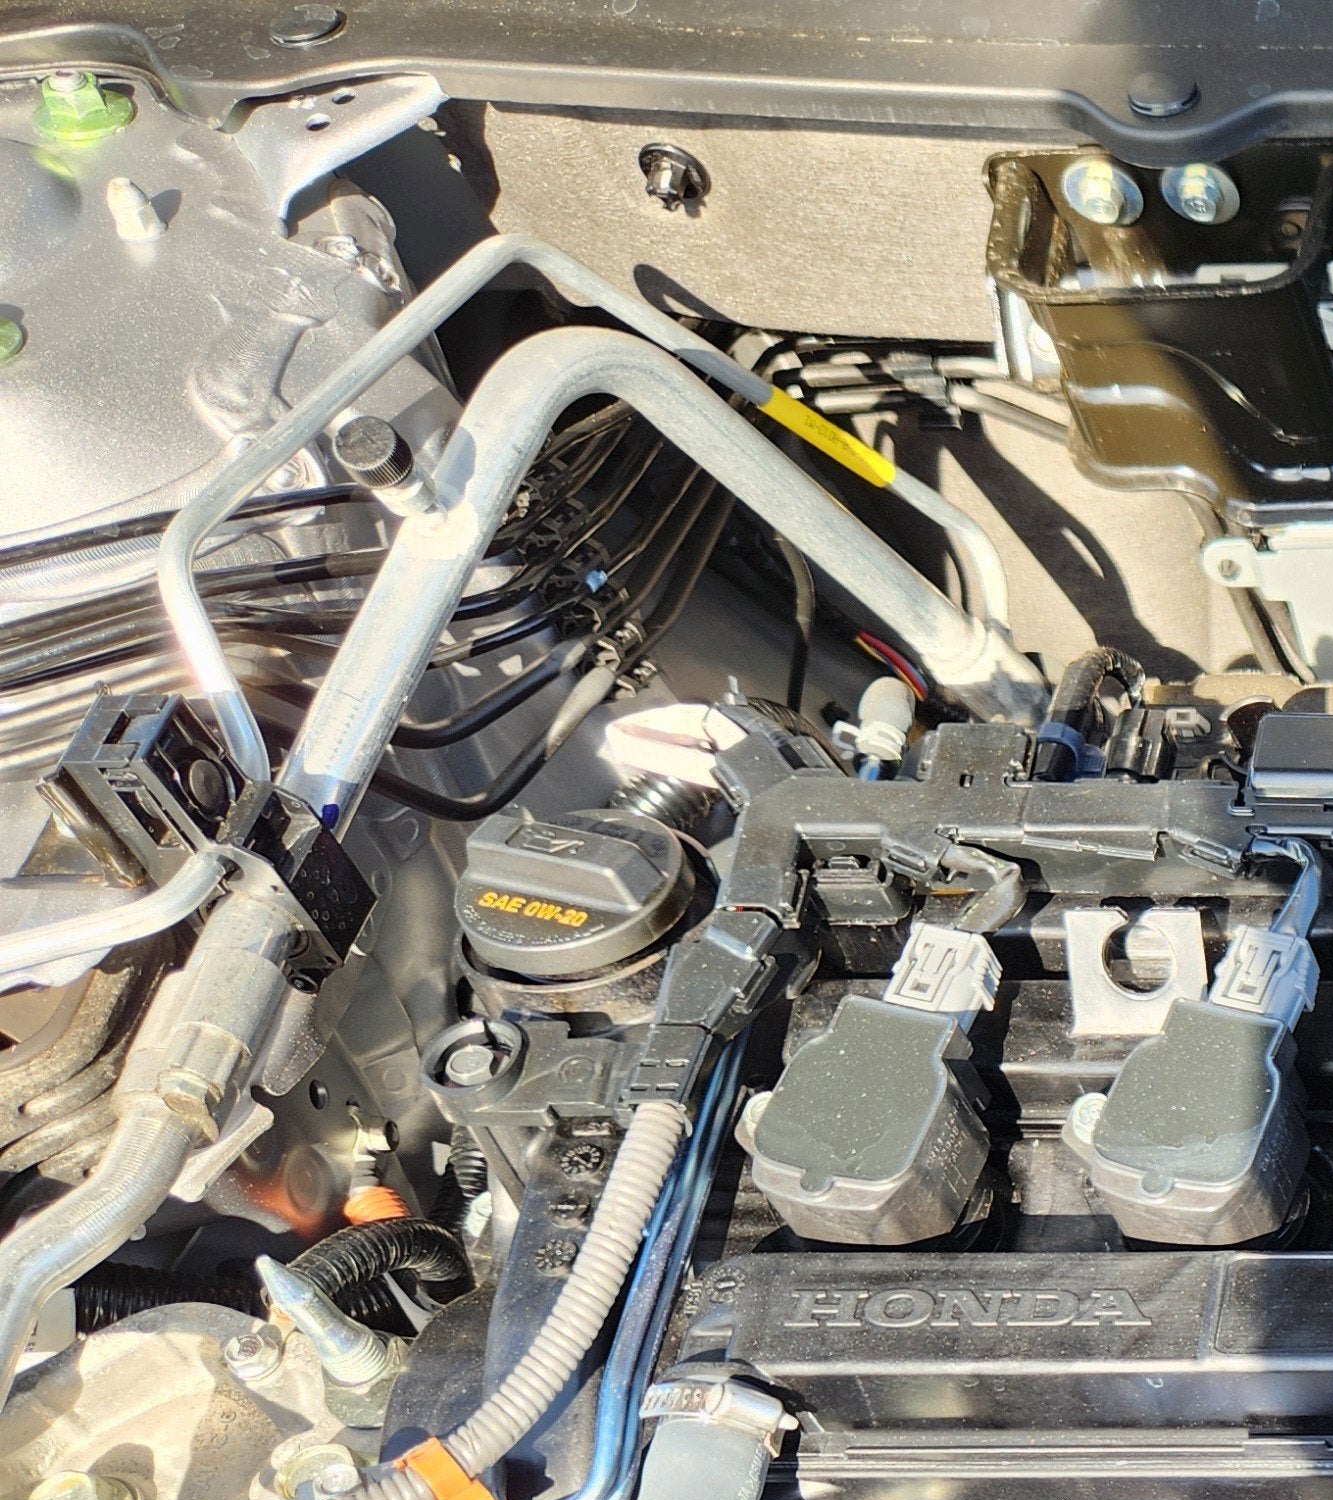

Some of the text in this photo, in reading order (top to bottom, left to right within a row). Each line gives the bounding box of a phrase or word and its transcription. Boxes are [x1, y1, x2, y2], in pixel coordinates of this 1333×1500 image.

[478, 892, 588, 927] SAE 0W-20
[784, 1288, 1152, 1327] HONDA
